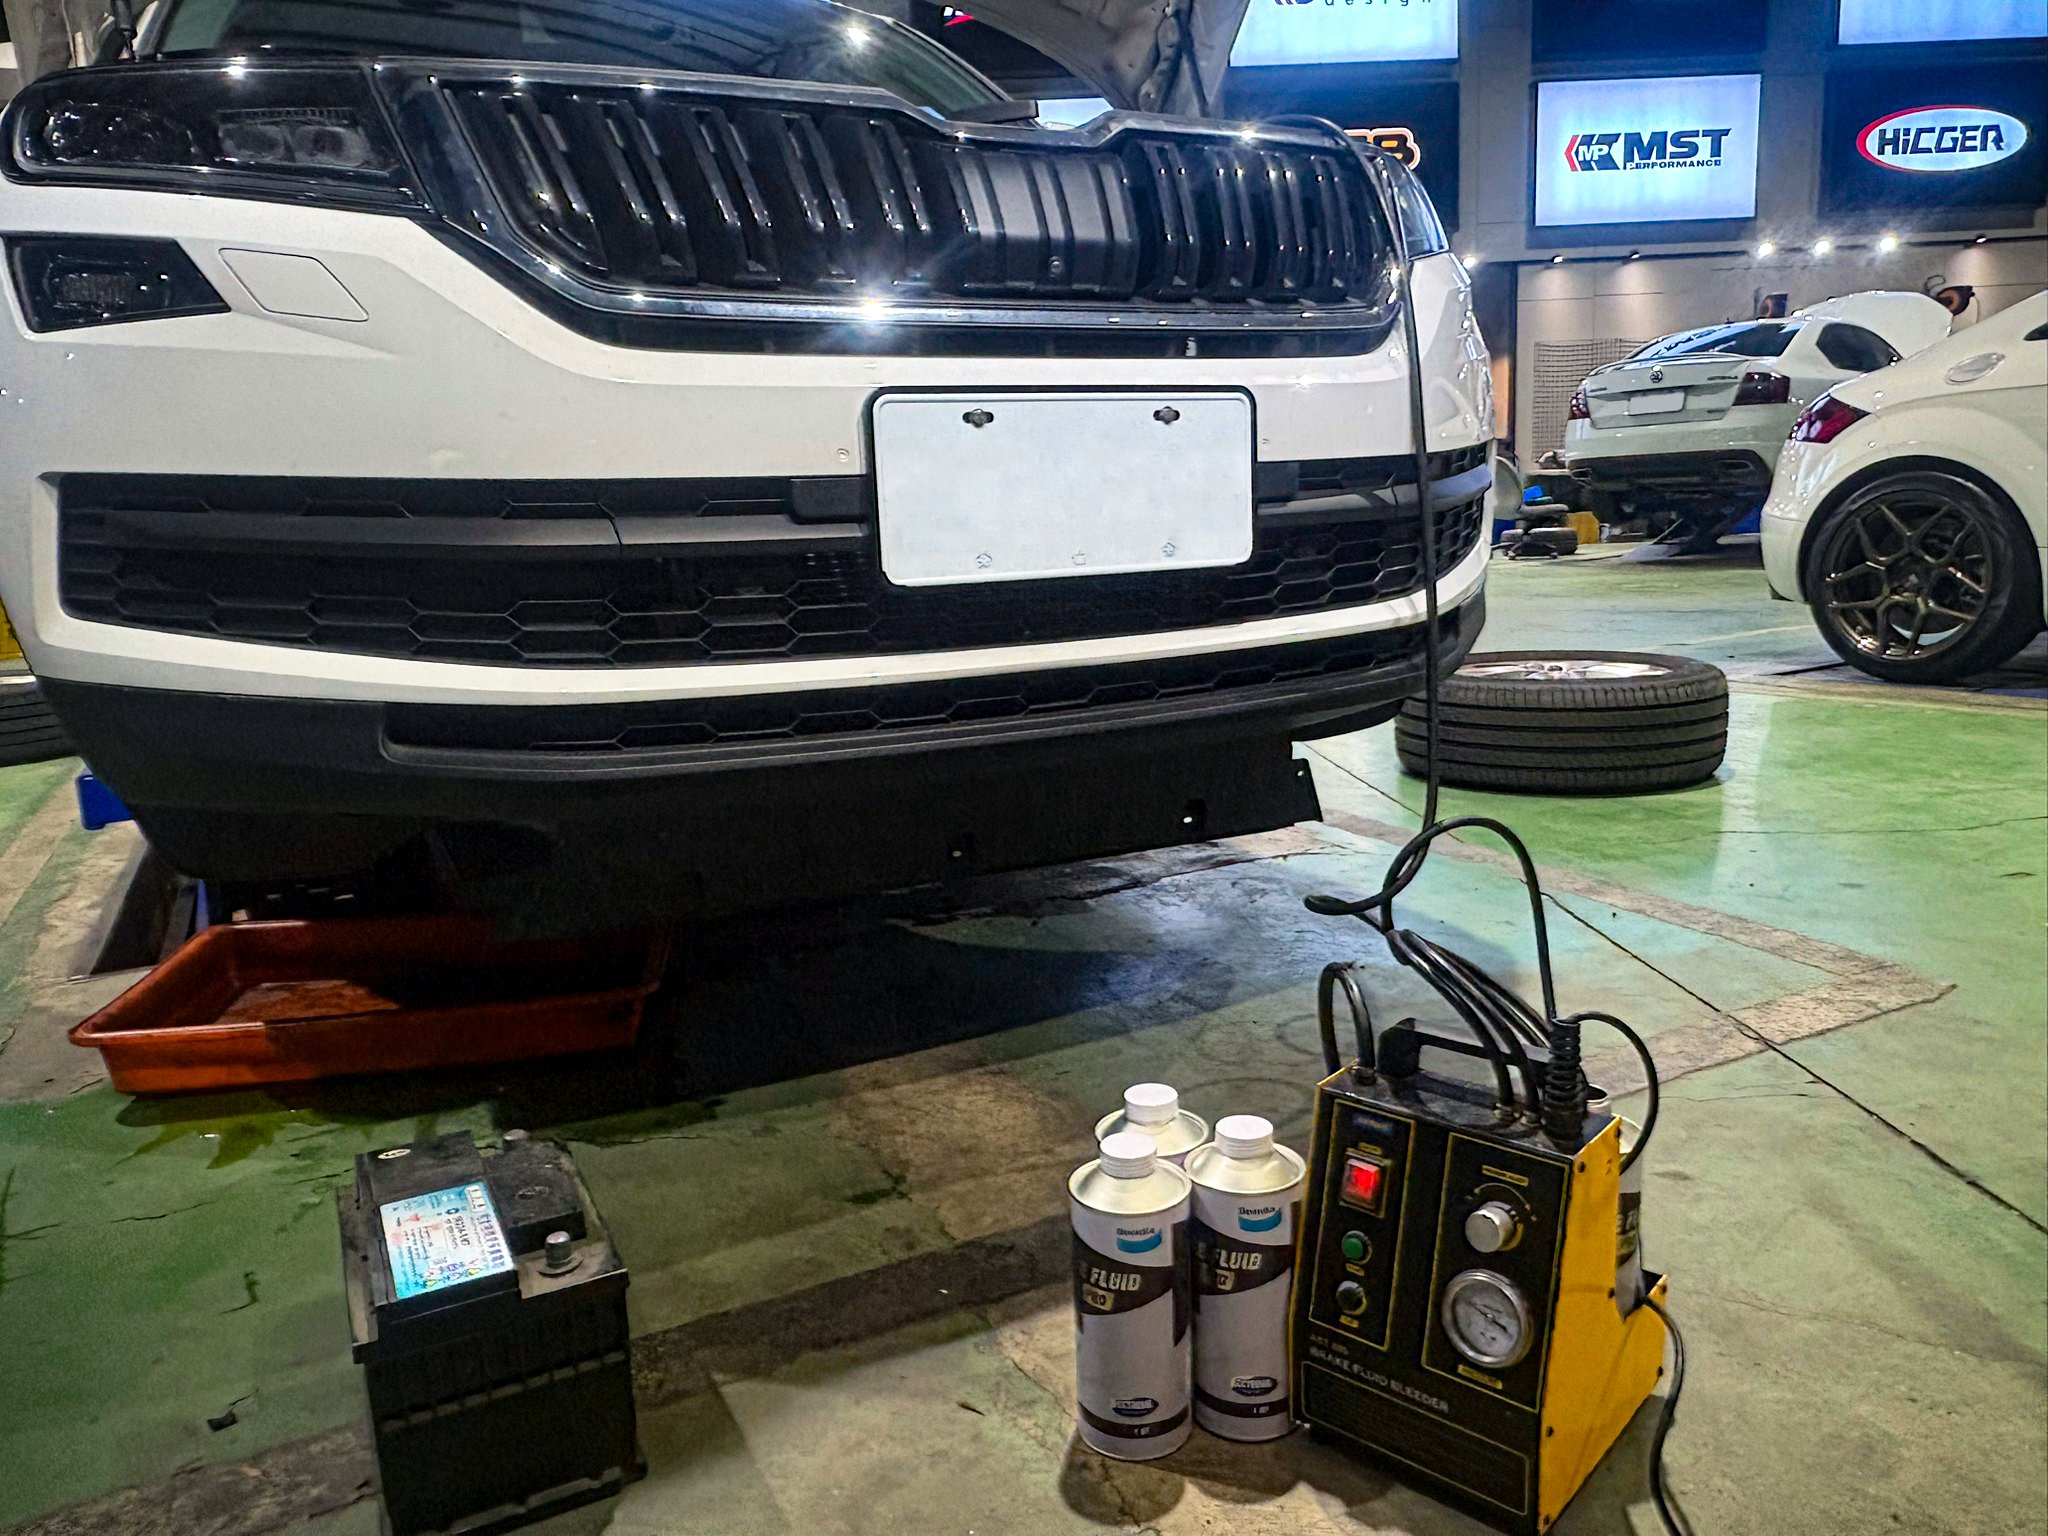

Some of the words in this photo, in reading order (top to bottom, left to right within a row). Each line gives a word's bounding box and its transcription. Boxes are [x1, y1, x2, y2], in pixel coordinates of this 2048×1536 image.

[1623, 128, 1732, 162] MST
[1624, 159, 1722, 170] PERFORMANCE
[1089, 1267, 1142, 1291] FLUID
